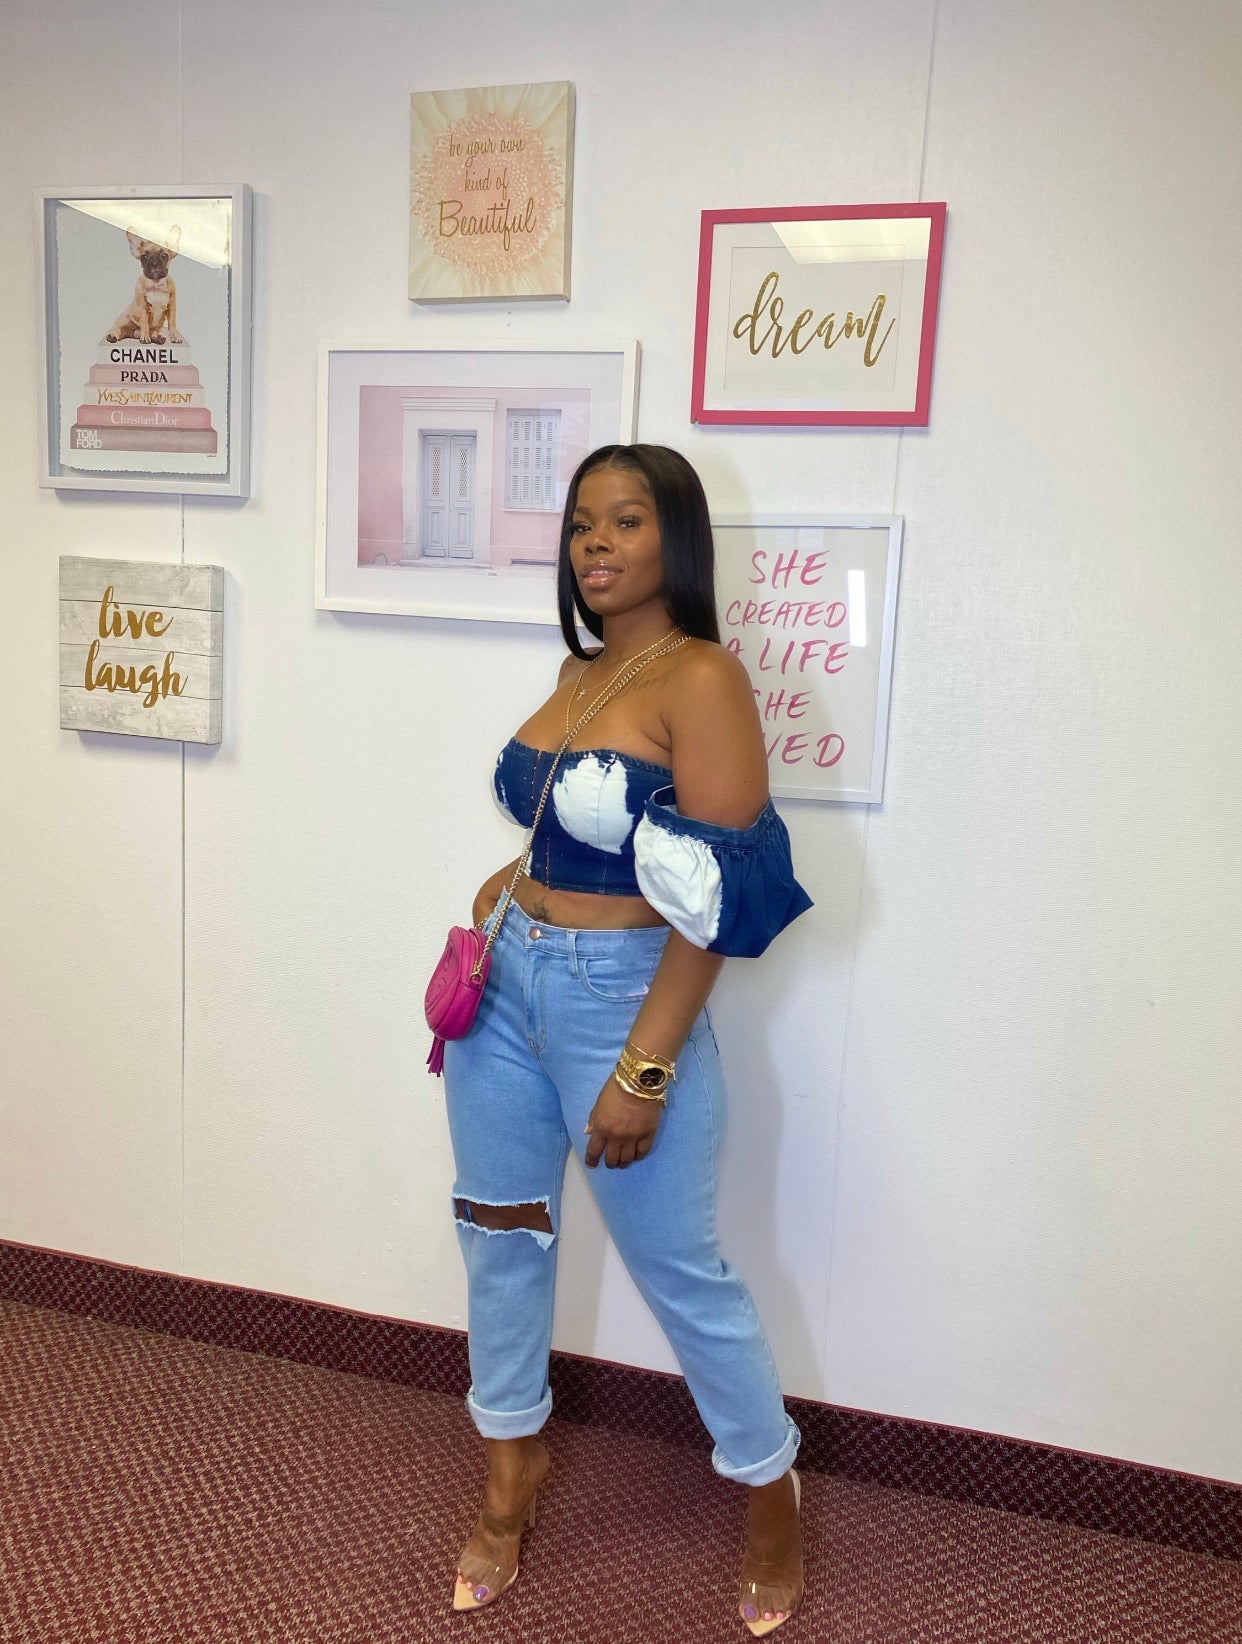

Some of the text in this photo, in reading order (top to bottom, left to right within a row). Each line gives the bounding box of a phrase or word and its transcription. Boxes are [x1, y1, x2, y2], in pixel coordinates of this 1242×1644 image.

[450, 135, 525, 168] be your own
[464, 167, 509, 200] kind of
[438, 197, 537, 251] Beautiful
[733, 271, 896, 367] dream
[110, 348, 178, 364] CHANEL
[120, 370, 168, 383] PRADA
[76, 429, 98, 439] TOM
[76, 438, 102, 449] FORD
[749, 549, 830, 589] SHE
[99, 585, 174, 640] live
[725, 599, 847, 629] CREATED
[759, 637, 850, 675] LIFE
[84, 638, 189, 708] laugh
[753, 688, 814, 721] HE
[762, 731, 845, 768] VED
